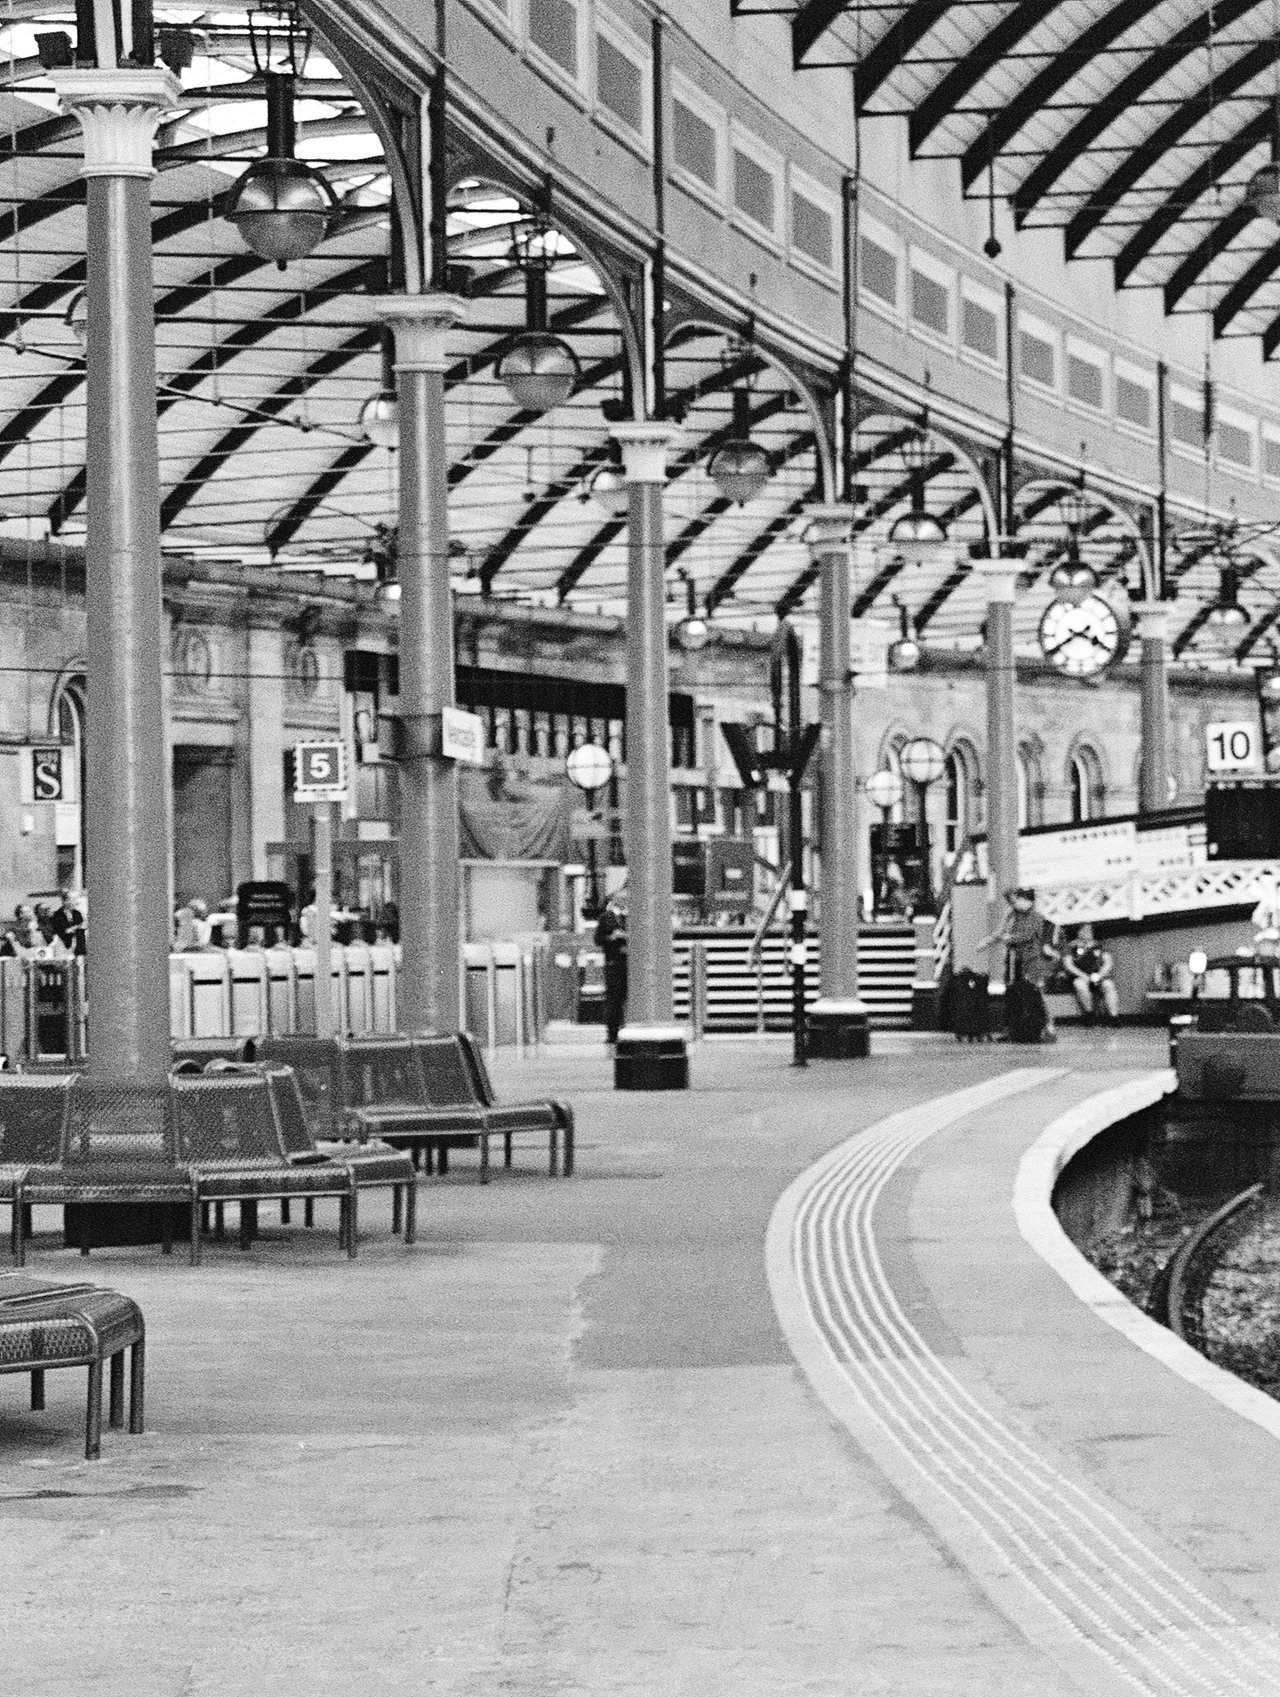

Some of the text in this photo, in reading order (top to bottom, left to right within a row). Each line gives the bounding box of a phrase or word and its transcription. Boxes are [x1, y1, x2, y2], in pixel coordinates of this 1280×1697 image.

[1212, 730, 1250, 760] 10
[36, 762, 60, 799] S
[309, 752, 331, 779] 5
